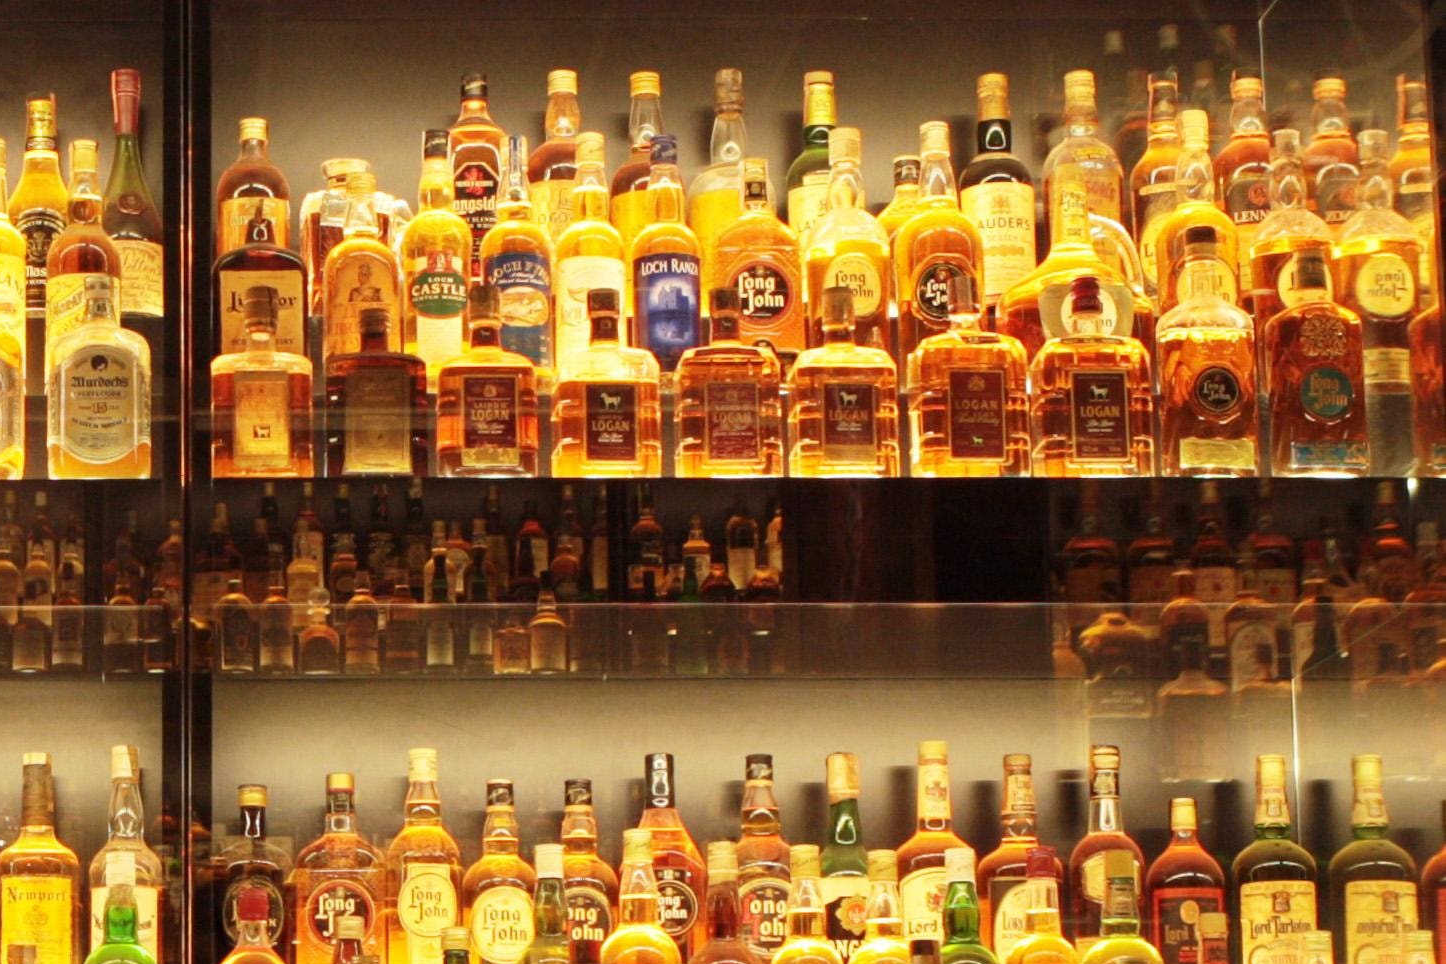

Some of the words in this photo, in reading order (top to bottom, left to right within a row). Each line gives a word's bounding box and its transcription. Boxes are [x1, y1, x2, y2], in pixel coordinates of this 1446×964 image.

[1234, 210, 1271, 223] LENN
[641, 259, 668, 277] LOCH
[411, 282, 467, 297] CASTLE
[737, 271, 776, 298] Long
[851, 284, 875, 299] ohn
[926, 279, 948, 298] Lon
[741, 289, 785, 316] John
[932, 292, 948, 306] Jo
[955, 399, 998, 411] LOGAN
[1080, 406, 1120, 418] LOGAN
[471, 409, 510, 421] LOGAN
[829, 410, 869, 422] LOGAN
[592, 421, 630, 432] LOGAN
[6, 886, 67, 905] Newport
[409, 886, 443, 910] Long
[658, 894, 682, 908] ong
[314, 896, 356, 919] Long
[413, 902, 449, 924] John
[483, 904, 521, 927] Long
[567, 904, 600, 925] ong
[483, 921, 528, 945] John
[572, 925, 605, 942] ohn
[908, 919, 938, 935] Lord
[1249, 920, 1271, 940] Lord
